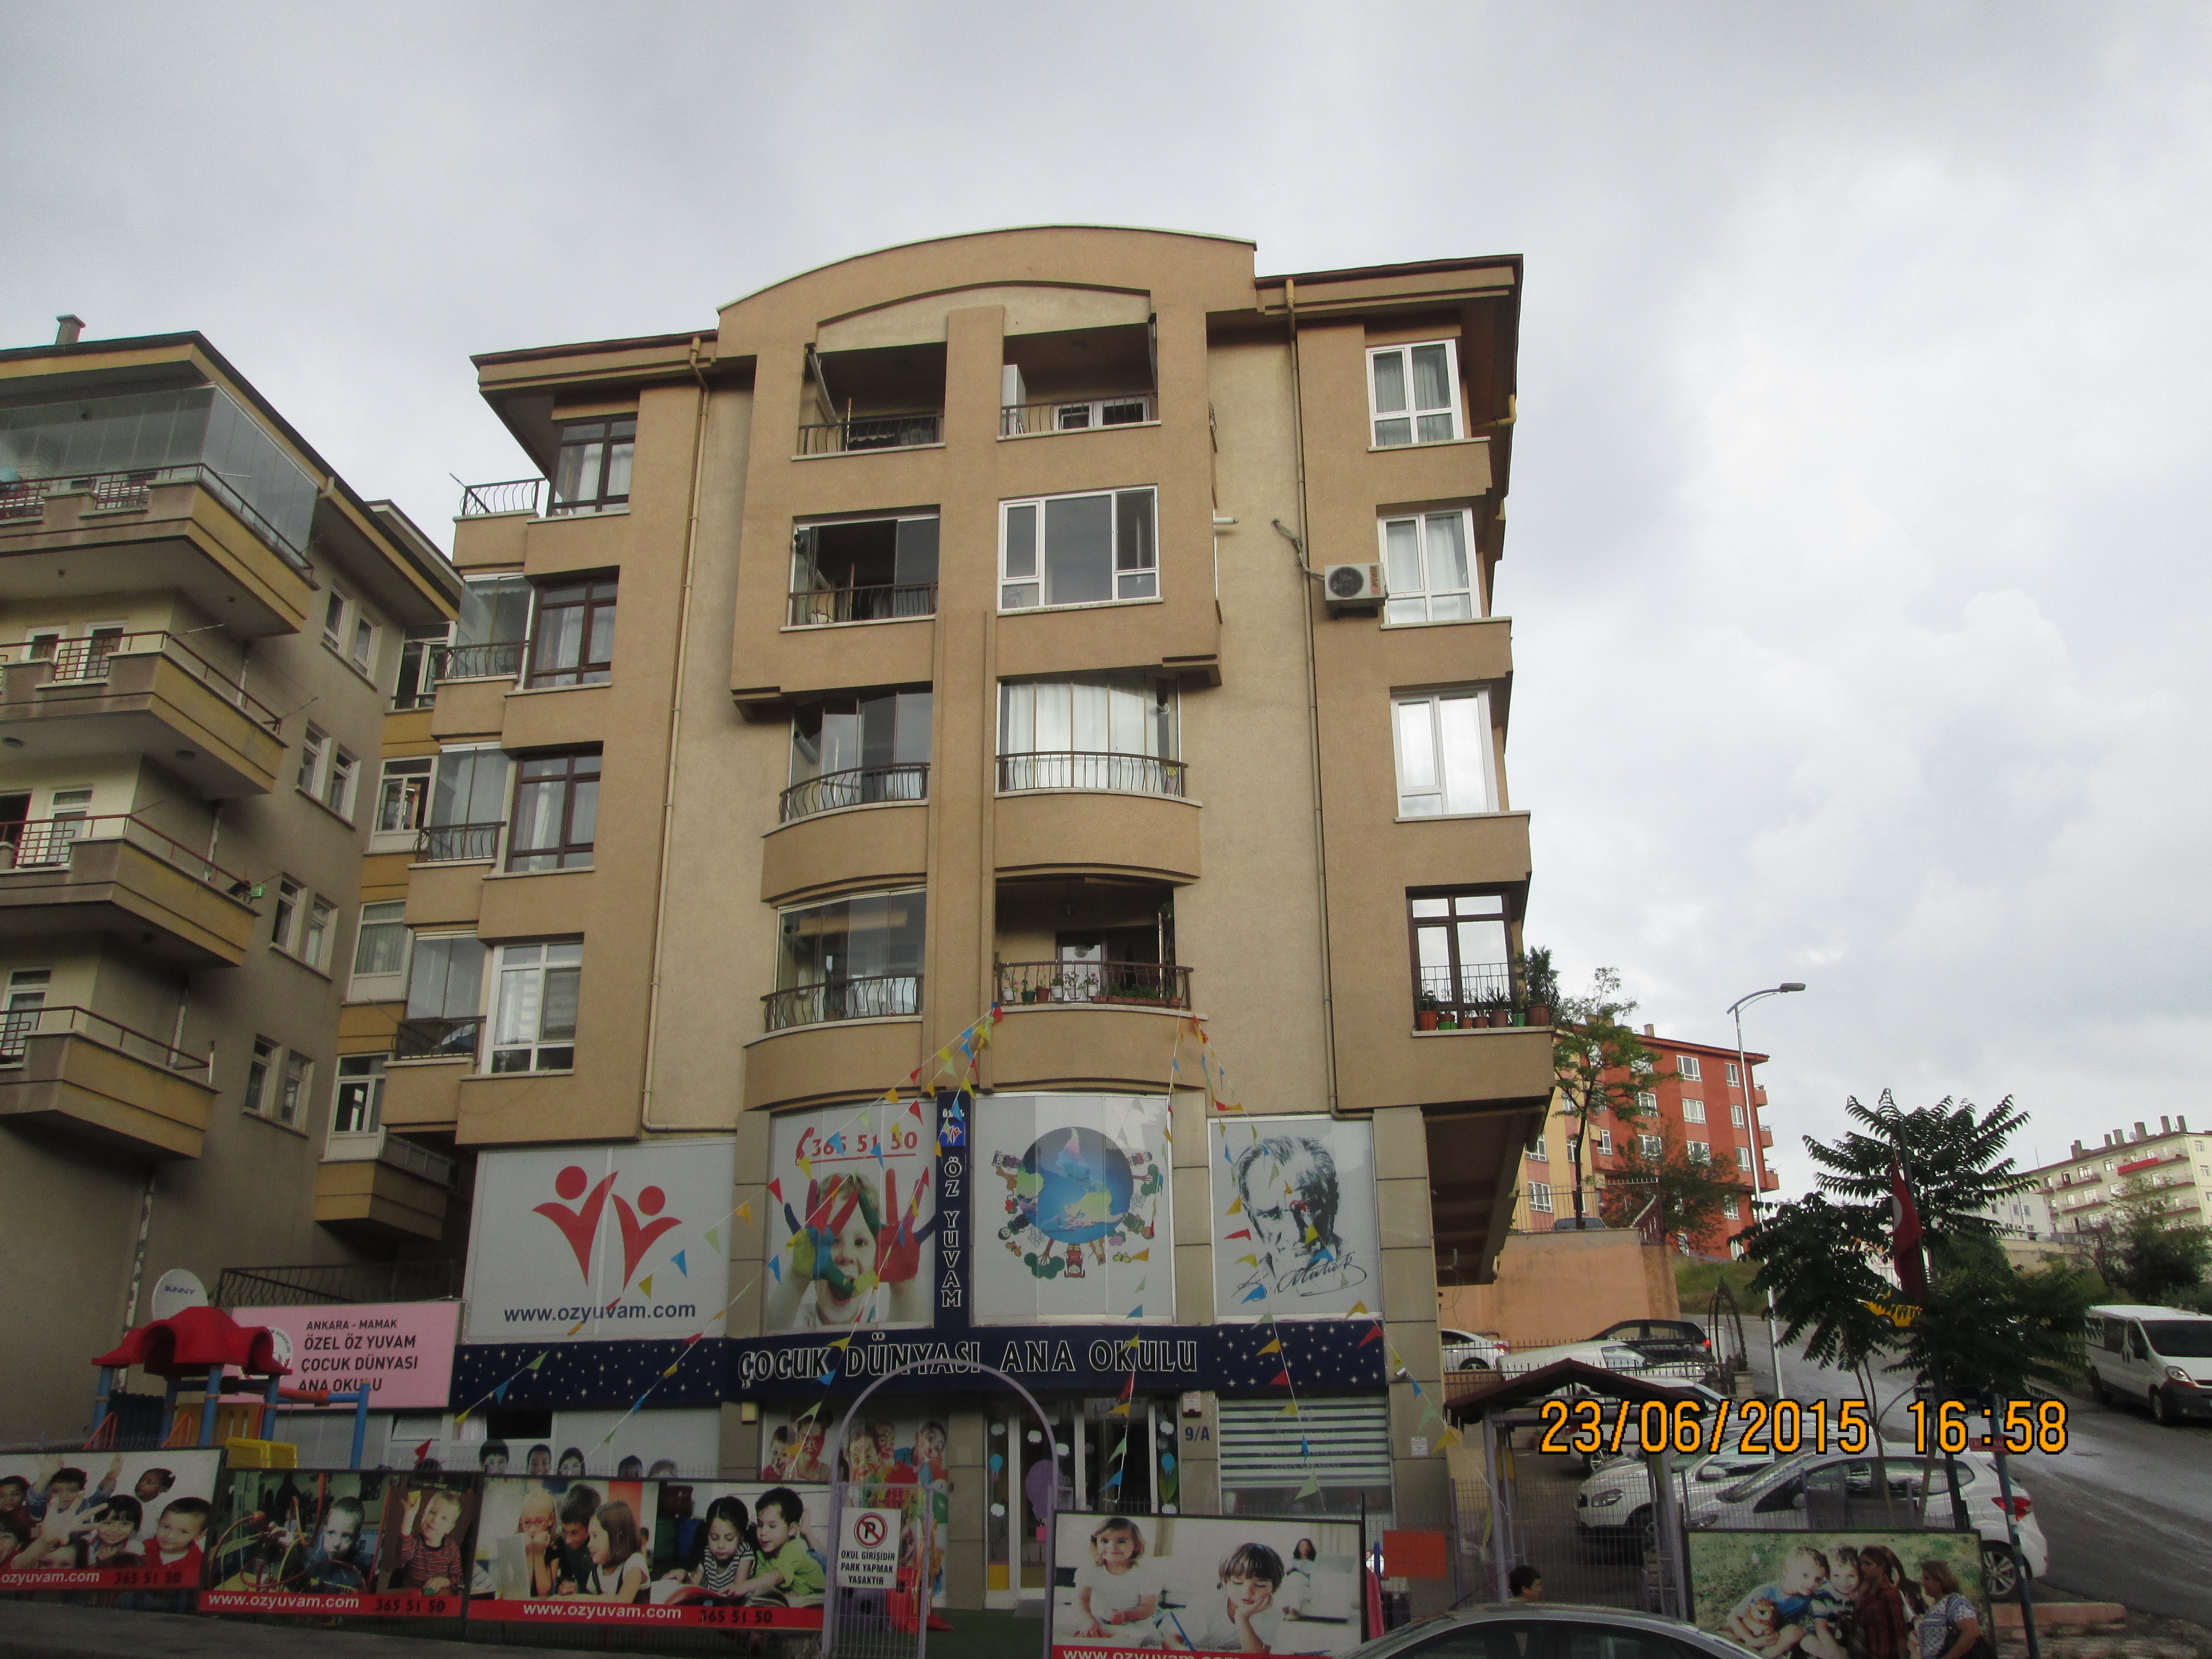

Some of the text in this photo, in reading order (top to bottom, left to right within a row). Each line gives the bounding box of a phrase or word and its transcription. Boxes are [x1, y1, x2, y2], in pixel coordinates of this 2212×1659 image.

[942, 1108, 965, 1118] ÖZL
[941, 1156, 962, 1308] ÖZ YUVAM
[504, 1303, 696, 1324] www.ozyuvam.com
[306, 1320, 349, 1330] ANKARA
[360, 1319, 397, 1329] MAMAK
[304, 1333, 416, 1350] ÖZEL ÖZ YUVAM
[301, 1353, 418, 1373] ÇOCUK DÜNYASI
[738, 1332, 1197, 1390] ÇOCUK DÜNYASI ANA OKULU
[299, 1378, 382, 1392] ANA OKUU
[1185, 1426, 1210, 1441] 9/A
[841, 1550, 895, 1562] OKUL GİRİŞİDİR
[841, 1563, 893, 1574] PARK YAPMAK
[848, 1575, 884, 1585] YASAKTIR
[208, 1594, 445, 1612] www.ozyuvam.com 365 51 50
[523, 1604, 772, 1623] www.ozyuvam.com 365 51 50
